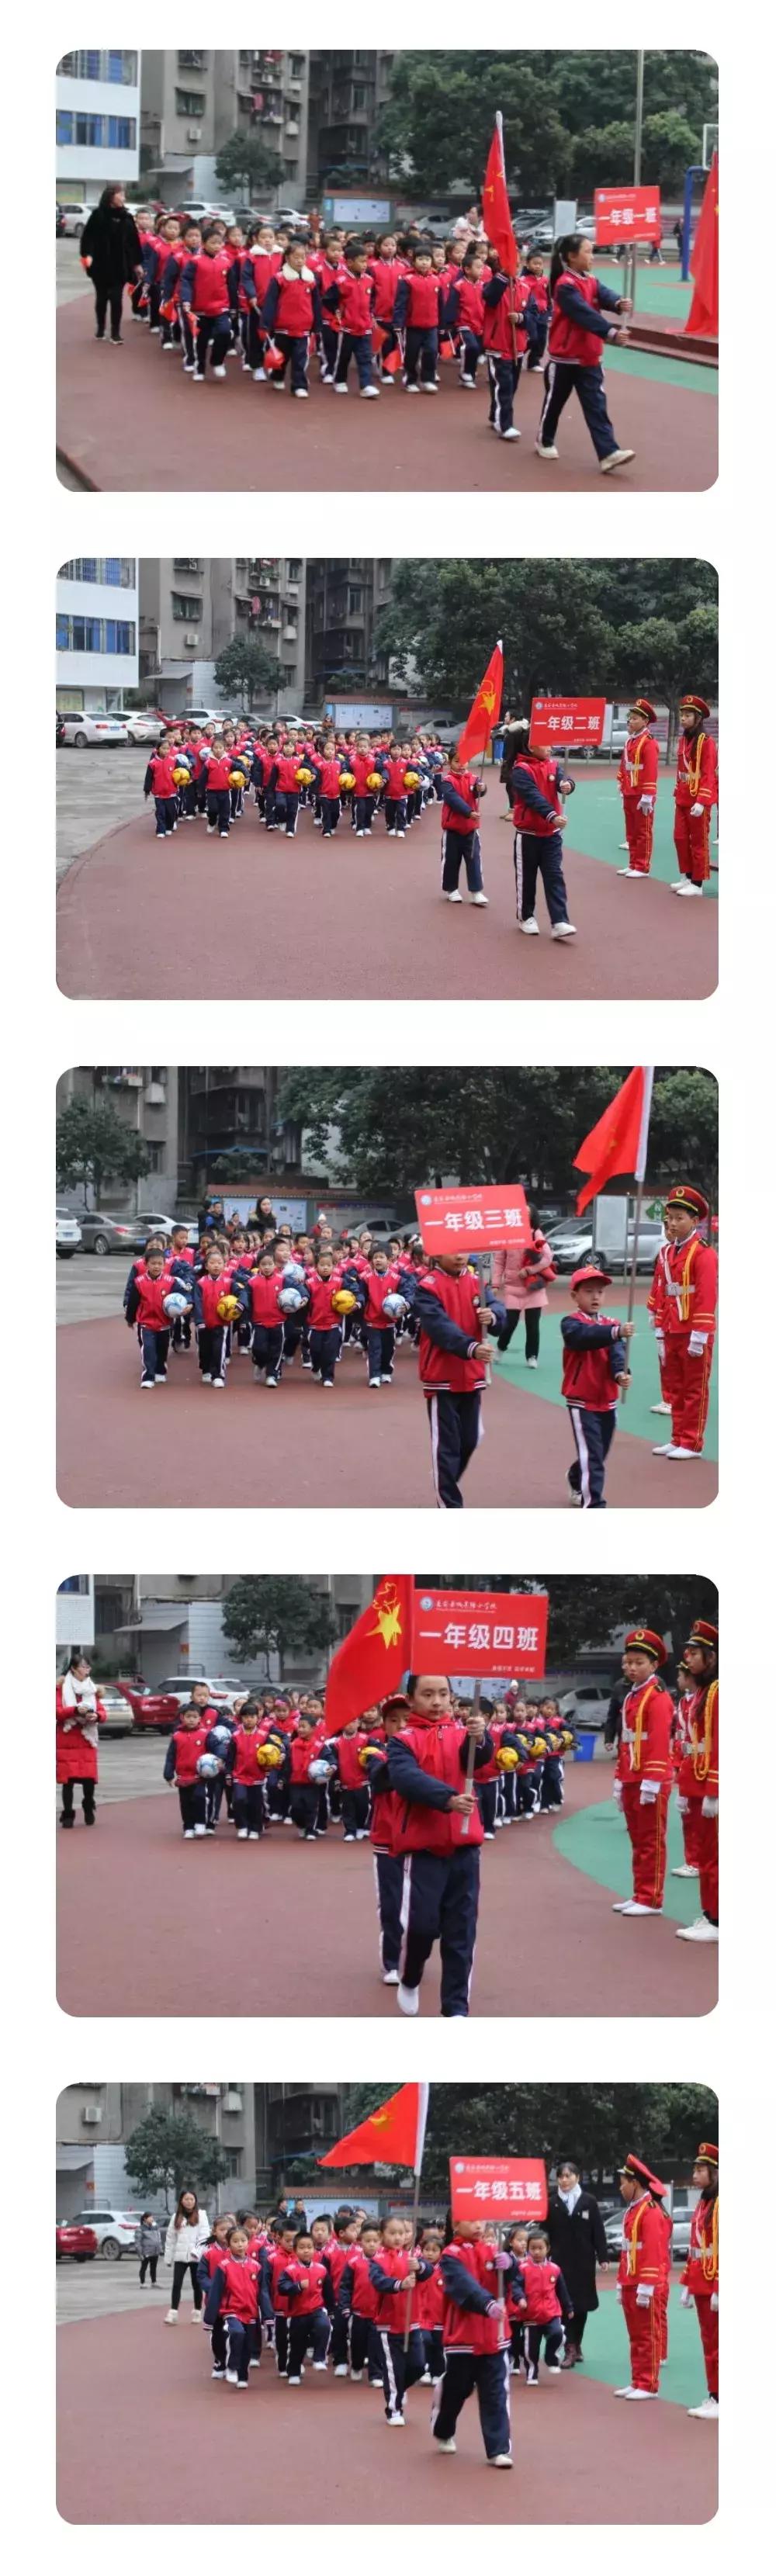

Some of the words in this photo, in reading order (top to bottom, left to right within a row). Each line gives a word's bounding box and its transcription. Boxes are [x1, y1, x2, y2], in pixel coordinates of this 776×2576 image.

[534, 715, 601, 731] 一年级二班
[424, 1208, 523, 1231] 一年级三班
[419, 1622, 539, 1651] 一年级四班
[456, 2181, 542, 2200] 一年级五班
